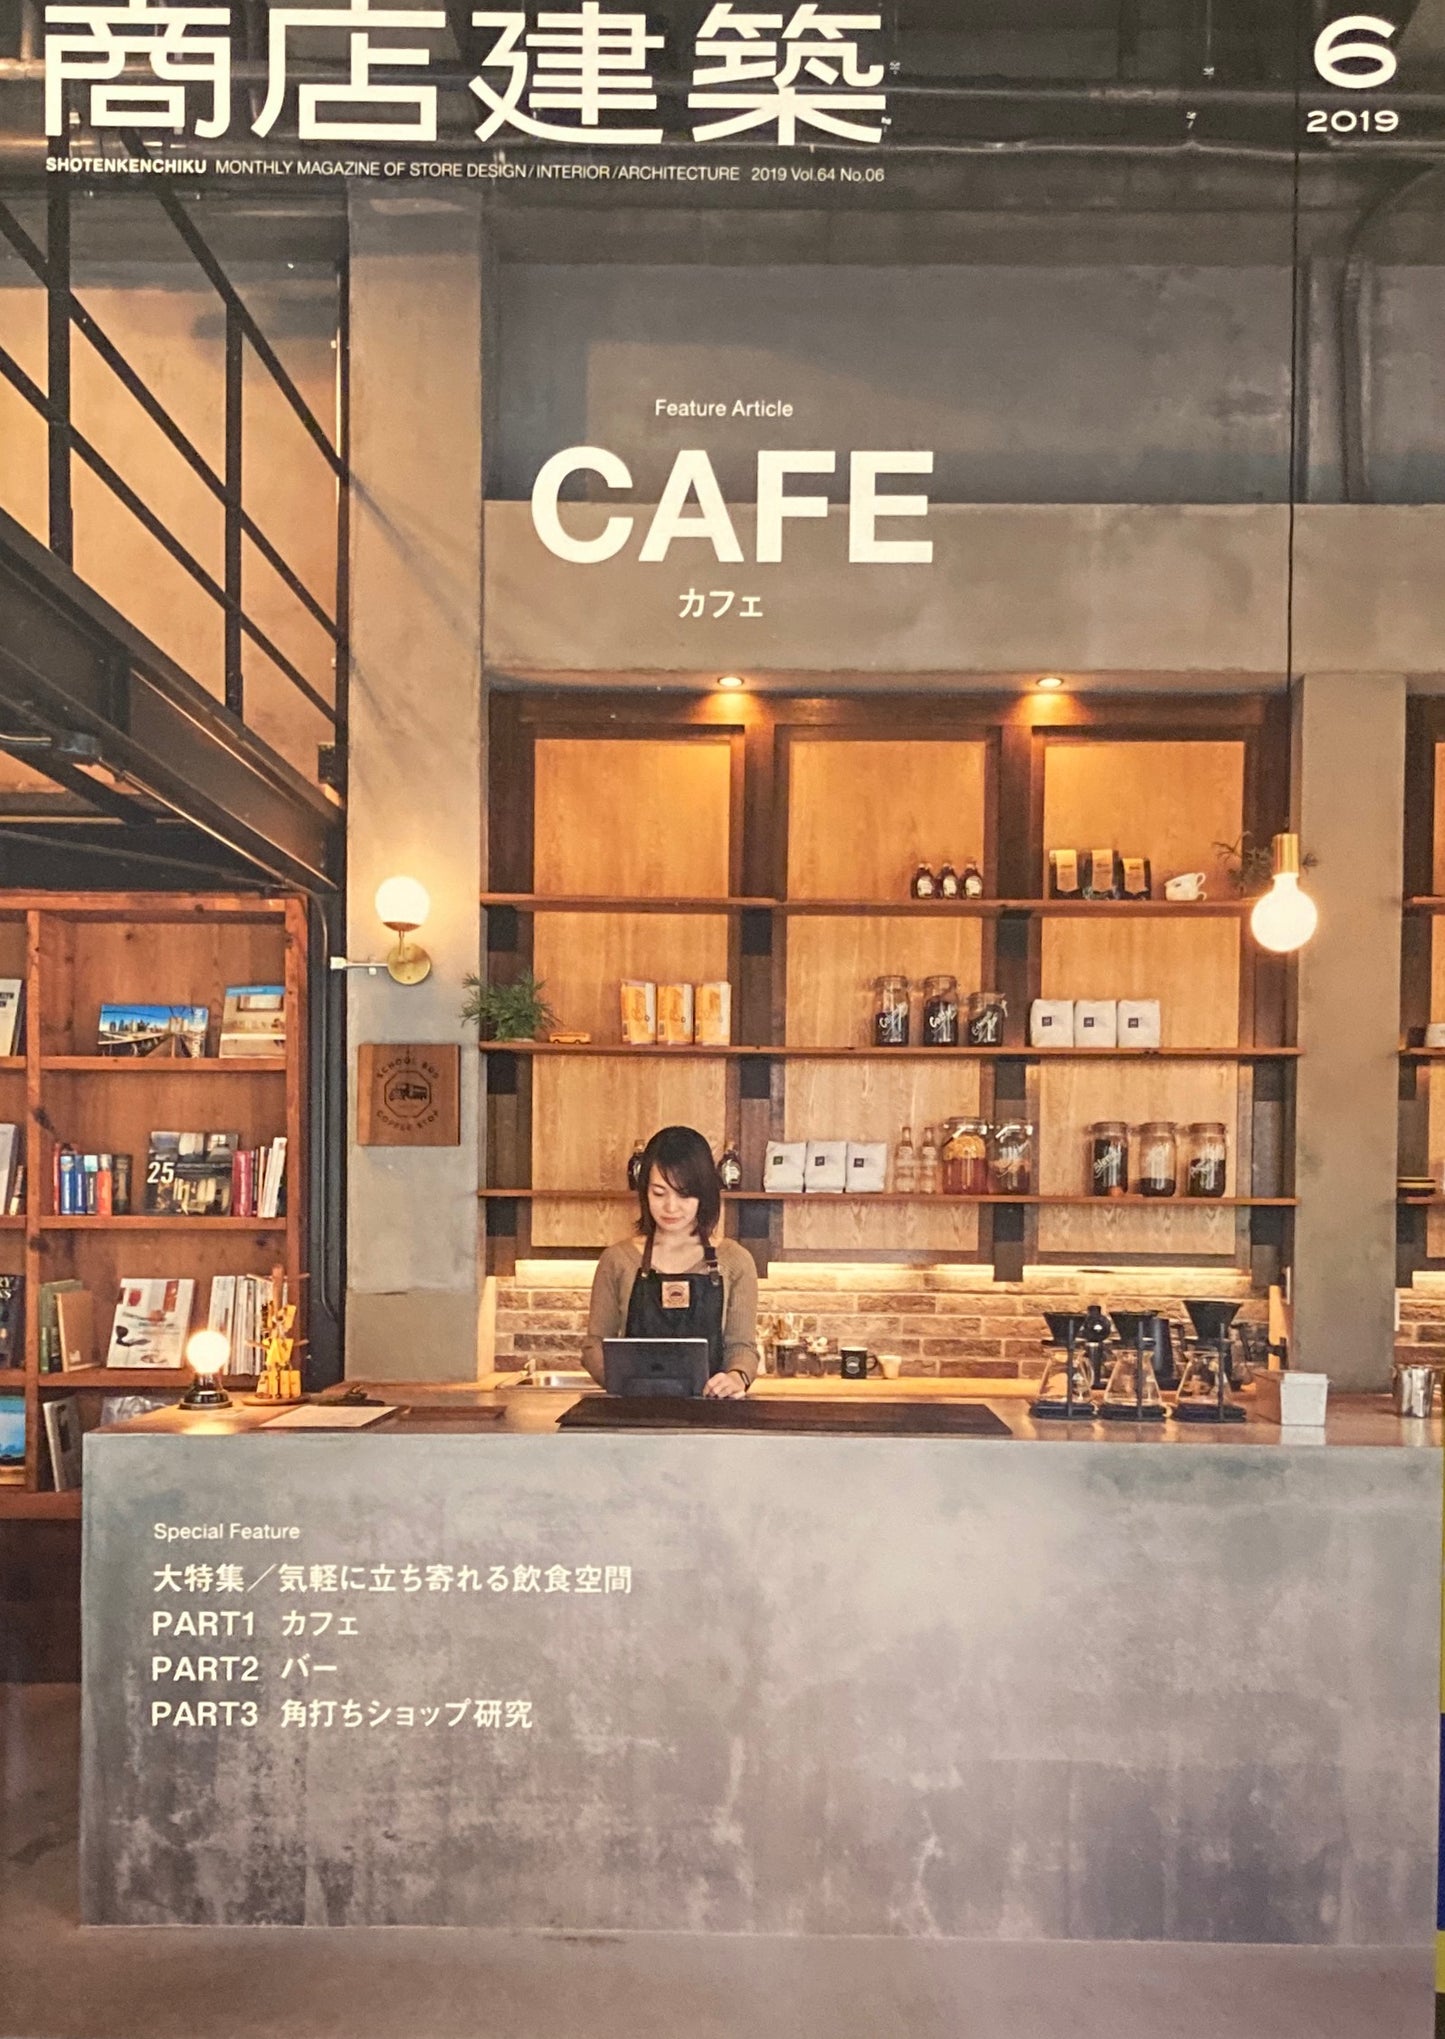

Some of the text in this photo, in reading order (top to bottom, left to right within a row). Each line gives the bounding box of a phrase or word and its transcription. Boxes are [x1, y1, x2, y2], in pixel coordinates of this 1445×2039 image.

[1313, 15, 1397, 89] 6
[45, 0, 887, 146] 商店建築
[1306, 110, 1399, 133] 2019
[45, 157, 207, 174] SHOTENKENCHIKU
[215, 160, 293, 175] MONTHLY
[297, 161, 380, 177] MAGAZINE
[383, 162, 406, 176] OF
[409, 163, 462, 178] STORE
[751, 166, 788, 182] 2019
[791, 167, 836, 182] Vol.64
[840, 167, 885, 182] No.06
[655, 398, 794, 417] Feature Article
[531, 446, 934, 564] CAFE
[679, 588, 763, 618] カフェ
[146, 1161, 175, 1184] 25
[154, 1522, 301, 1543] Special Feature
[152, 1609, 359, 1636] PART1 カフェ
[152, 1653, 338, 1681] PART2 バー
[152, 1698, 533, 1729] PART3 角打ちショップ研究
